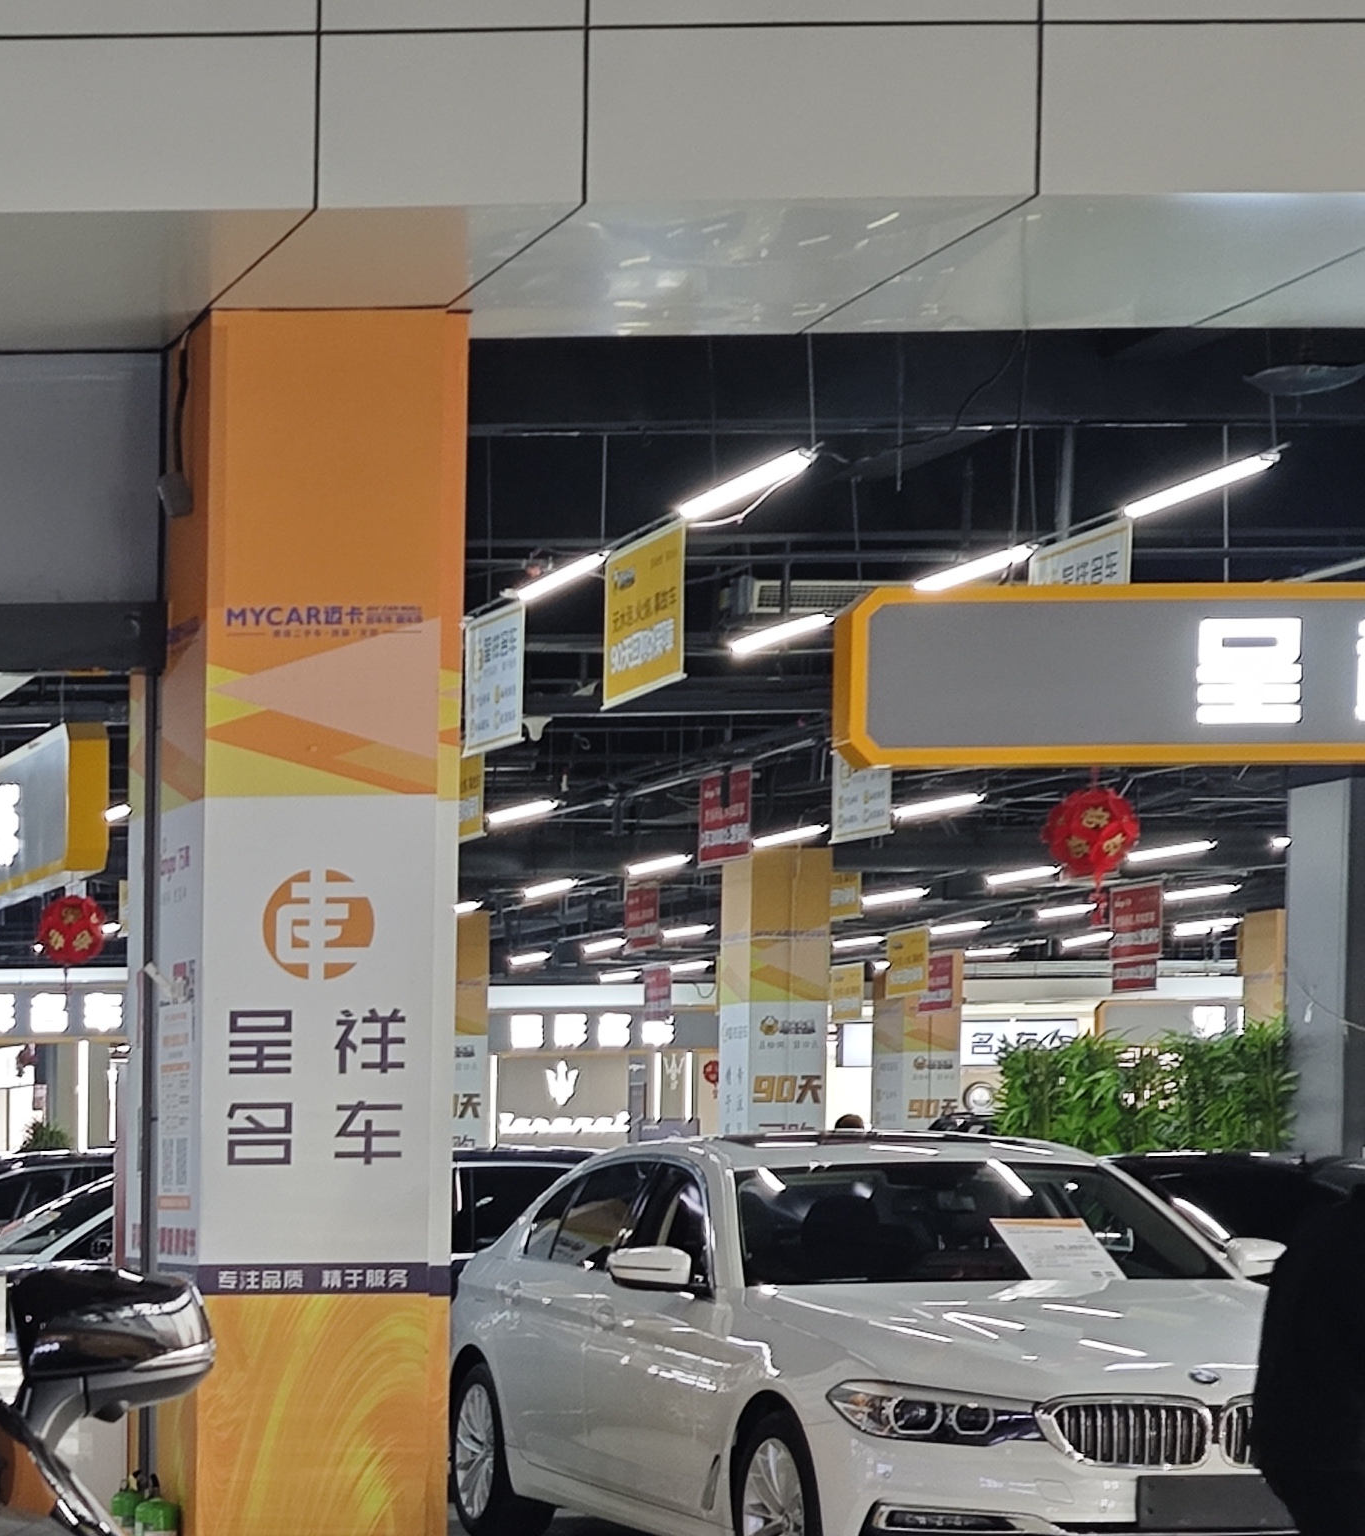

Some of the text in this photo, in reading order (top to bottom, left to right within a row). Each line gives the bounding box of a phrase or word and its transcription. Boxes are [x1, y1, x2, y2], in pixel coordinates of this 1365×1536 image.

[227, 1008, 406, 1074] 呈祥
[752, 1075, 823, 1105] 90天
[226, 1100, 403, 1166] 名车
[218, 1268, 410, 1291] 专注品质 精于服务
